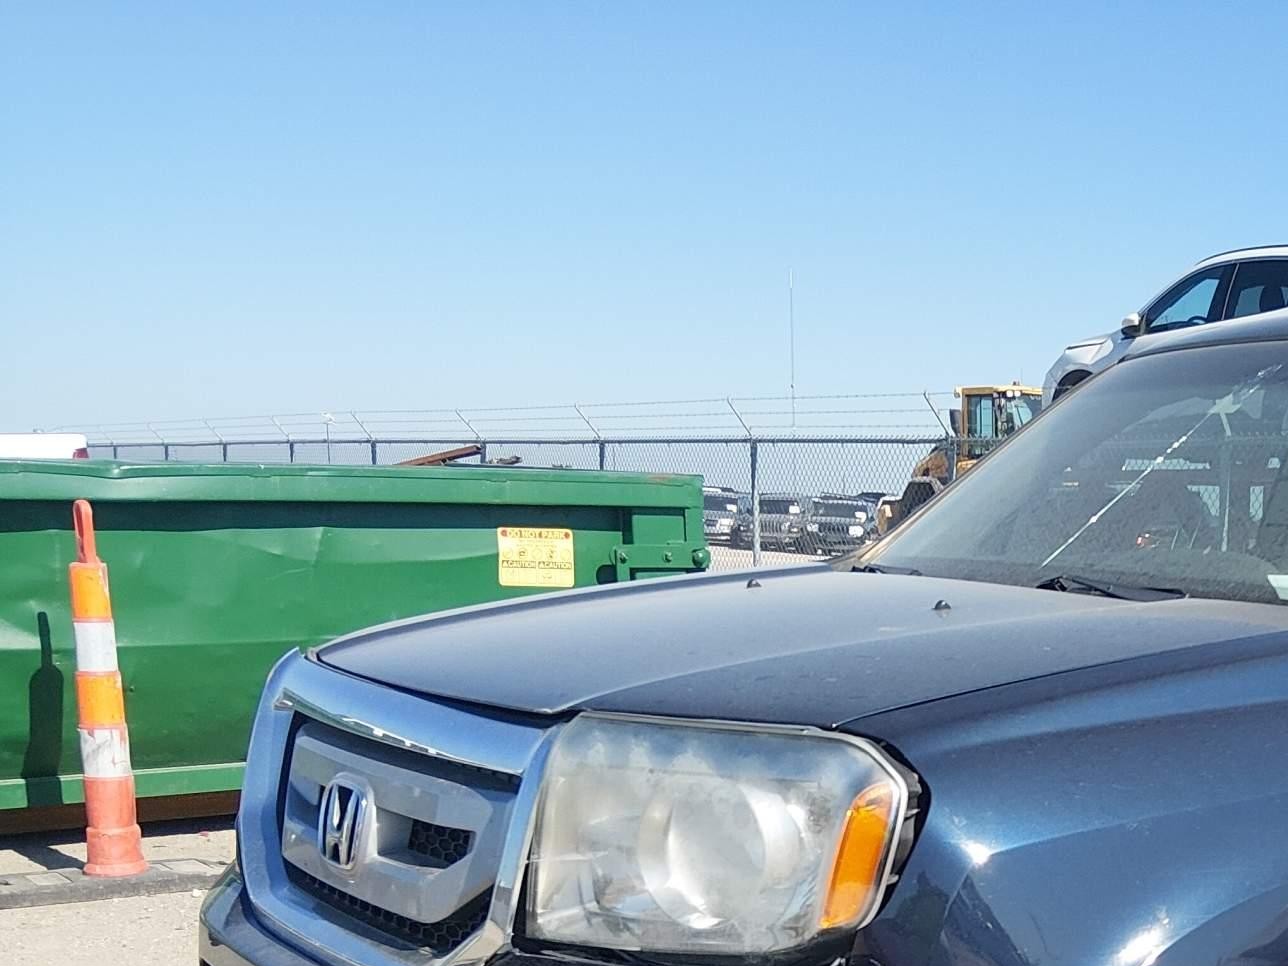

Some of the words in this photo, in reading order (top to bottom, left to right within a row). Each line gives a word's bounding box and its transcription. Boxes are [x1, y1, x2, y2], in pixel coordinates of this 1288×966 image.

[508, 529, 520, 538] DO
[521, 530, 540, 539] NOT
[507, 560, 536, 569] CAUTION
